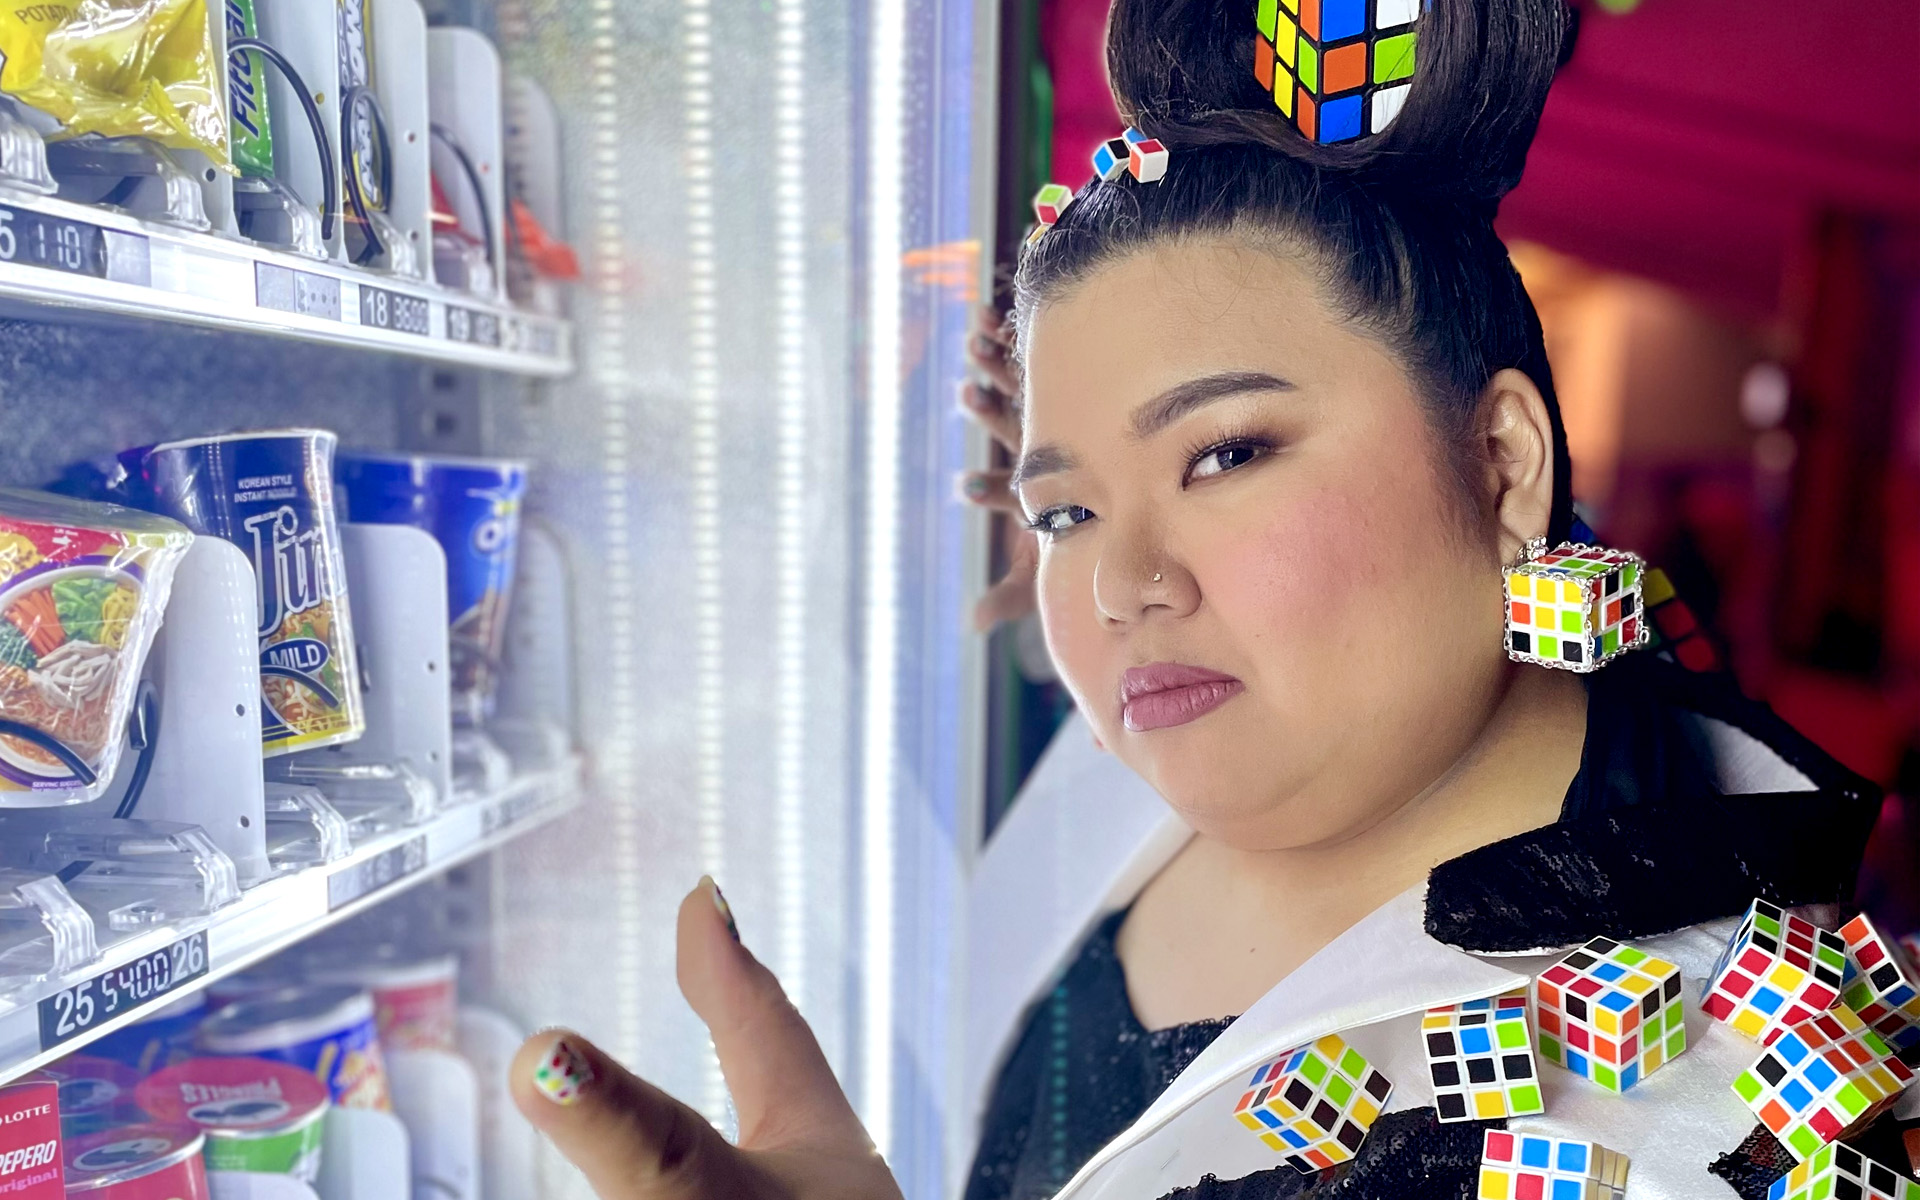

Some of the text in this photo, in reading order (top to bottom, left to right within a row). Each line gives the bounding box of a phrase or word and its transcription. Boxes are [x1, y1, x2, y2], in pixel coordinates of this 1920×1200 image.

[366, 290, 388, 327] 18
[238, 474, 292, 489] KOREAN STYLE
[234, 490, 267, 503] INSTANT
[269, 644, 321, 670] MILD
[172, 933, 204, 981] 26
[54, 981, 95, 1037] 25
[4, 1103, 51, 1124] LOTTE
[0, 1168, 58, 1194] riginal
